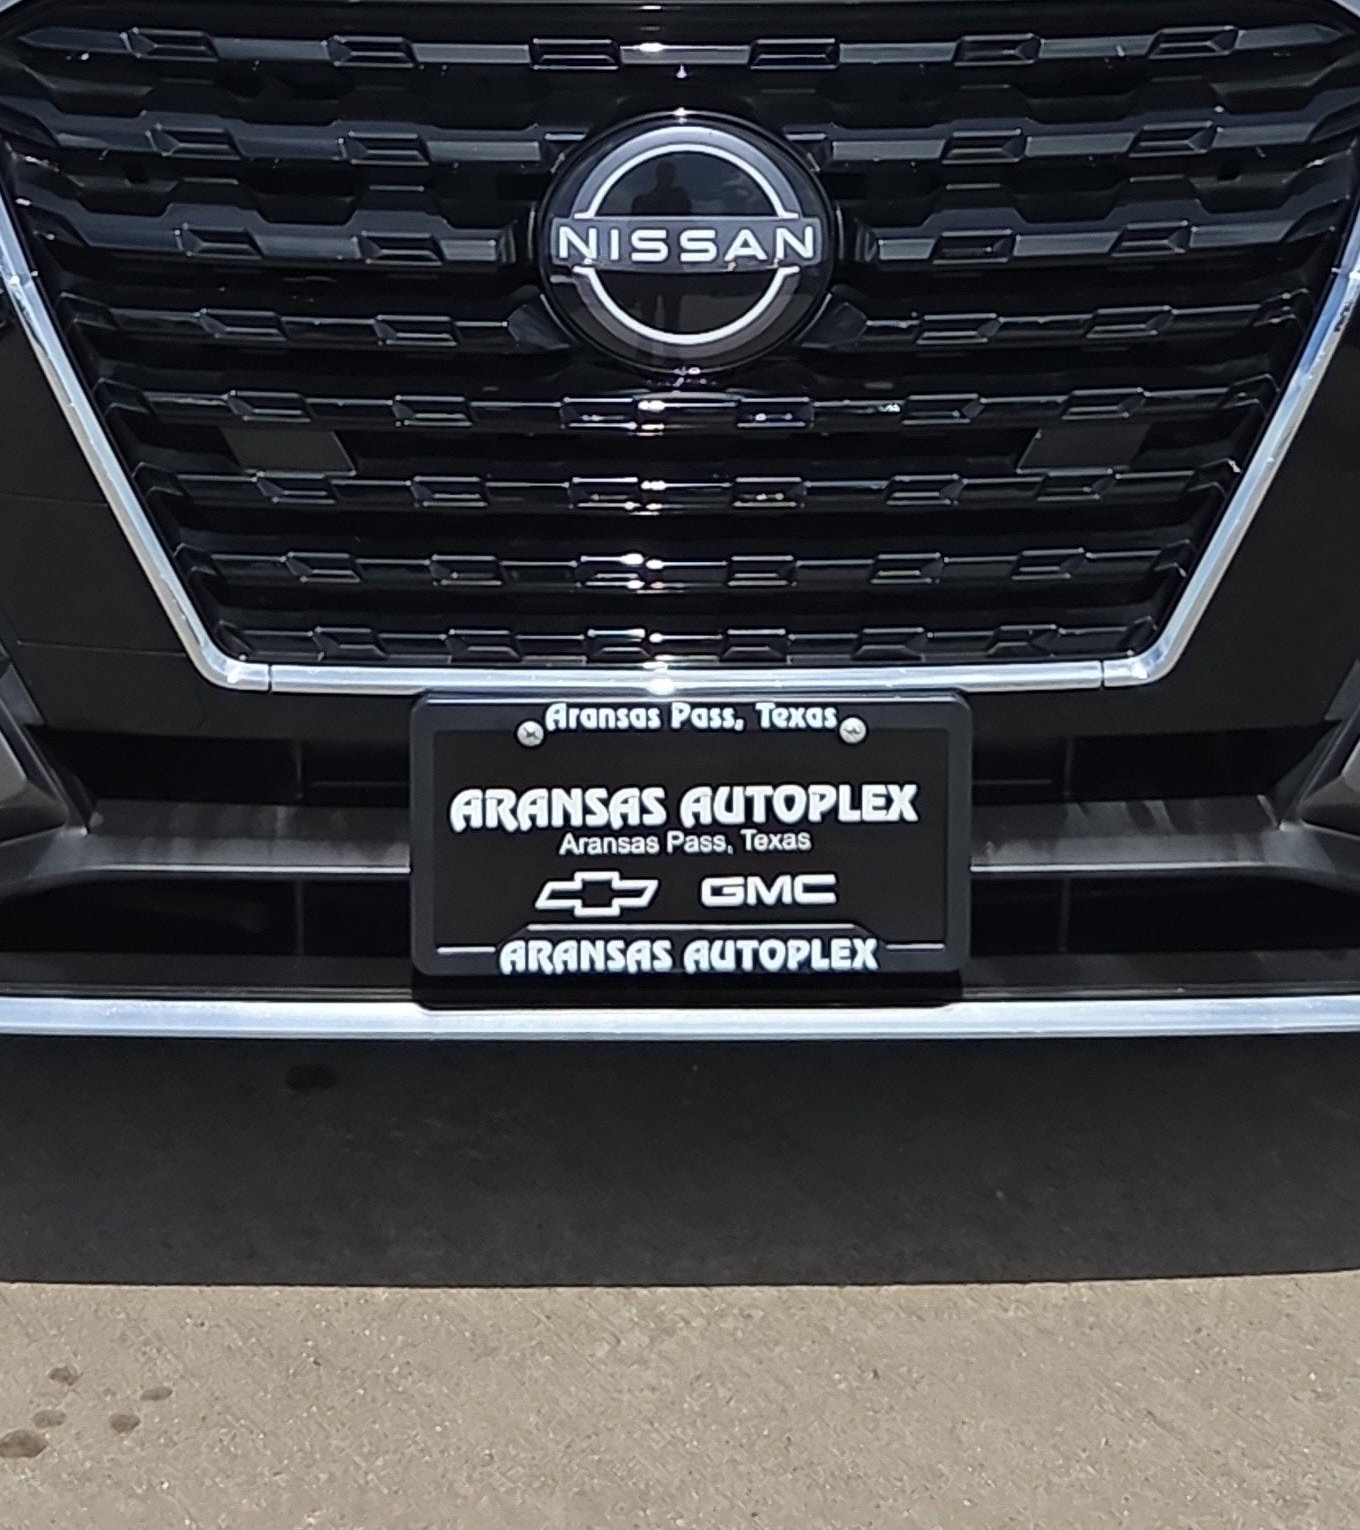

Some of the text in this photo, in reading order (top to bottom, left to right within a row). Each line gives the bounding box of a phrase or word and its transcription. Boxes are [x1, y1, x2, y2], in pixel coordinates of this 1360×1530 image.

[558, 226, 814, 262] NISSAN
[545, 701, 838, 732] Aransas Pass, Texas
[449, 783, 919, 832] ARANSAS AUTOPLEX
[558, 830, 811, 856] Aransas Pass, Texas
[700, 873, 838, 907] GMC
[498, 938, 879, 974] ARANSAS AUTOPLEX
